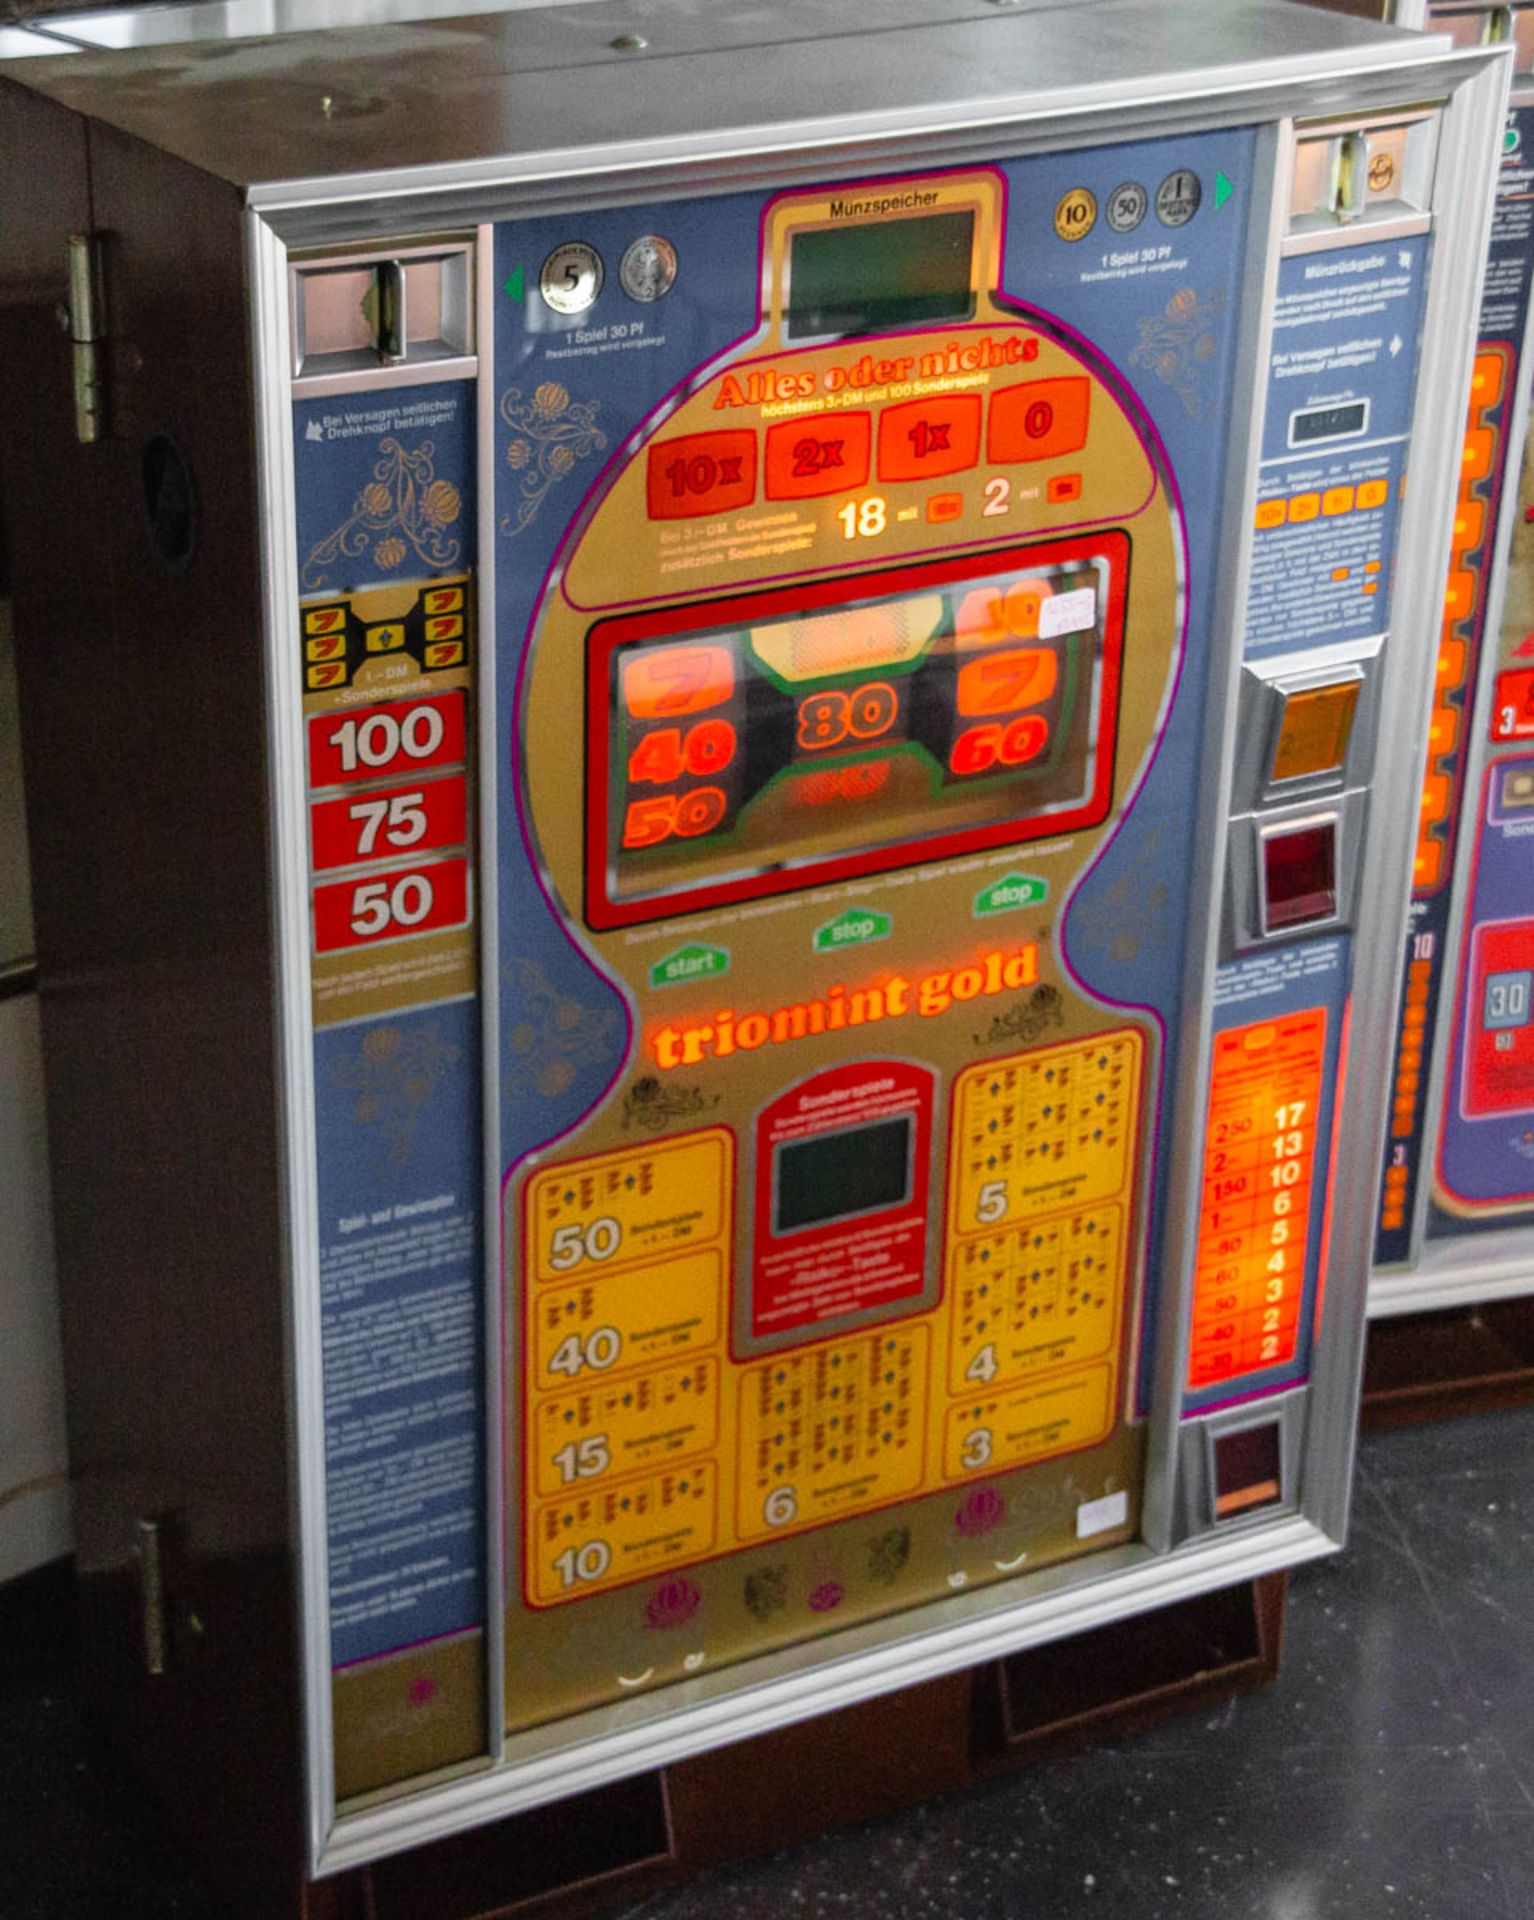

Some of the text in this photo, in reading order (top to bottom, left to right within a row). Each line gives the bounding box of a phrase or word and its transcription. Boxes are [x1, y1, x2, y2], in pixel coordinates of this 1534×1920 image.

[1065, 204, 1087, 224] 10
[1117, 198, 1137, 217] 50
[563, 264, 579, 291] 5
[574, 326, 608, 345] Spiel
[610, 324, 628, 340] 30
[630, 321, 645, 336] Pf
[712, 335, 1040, 410] Alles oder nichts
[889, 386, 912, 399] 100
[908, 419, 952, 459] 1x
[1024, 400, 1054, 440] 0
[664, 453, 744, 498] 10x
[791, 437, 846, 478] 2x
[982, 475, 1011, 517] 2
[837, 496, 887, 540] 18
[797, 681, 899, 750] 80
[329, 704, 445, 772] 100
[628, 718, 737, 785] 40
[949, 713, 1050, 776] 60
[349, 791, 428, 856] 75
[622, 785, 727, 848] 50
[350, 873, 434, 936] 50
[990, 883, 1033, 907] stop
[830, 917, 876, 943] stop
[1413, 932, 1434, 960] 10
[665, 951, 715, 979] start
[653, 941, 1040, 1070] triomint gold
[1490, 983, 1525, 1018] 30
[1274, 1100, 1307, 1130] 17
[1271, 1131, 1304, 1159] 13
[1268, 1160, 1300, 1188] 10
[976, 1178, 1009, 1224] 5
[1273, 1190, 1292, 1216] 6
[549, 1215, 622, 1271] 50
[1270, 1219, 1289, 1245] 5
[1266, 1249, 1286, 1273] 4
[1265, 1278, 1284, 1303] 3
[1262, 1307, 1280, 1333] 2
[547, 1325, 622, 1376] 40
[965, 1343, 998, 1383] 4
[1259, 1334, 1280, 1361] 2
[552, 1433, 611, 1484] 15
[960, 1427, 993, 1469] 3
[763, 1484, 798, 1528] 6
[553, 1540, 612, 1587] 10
